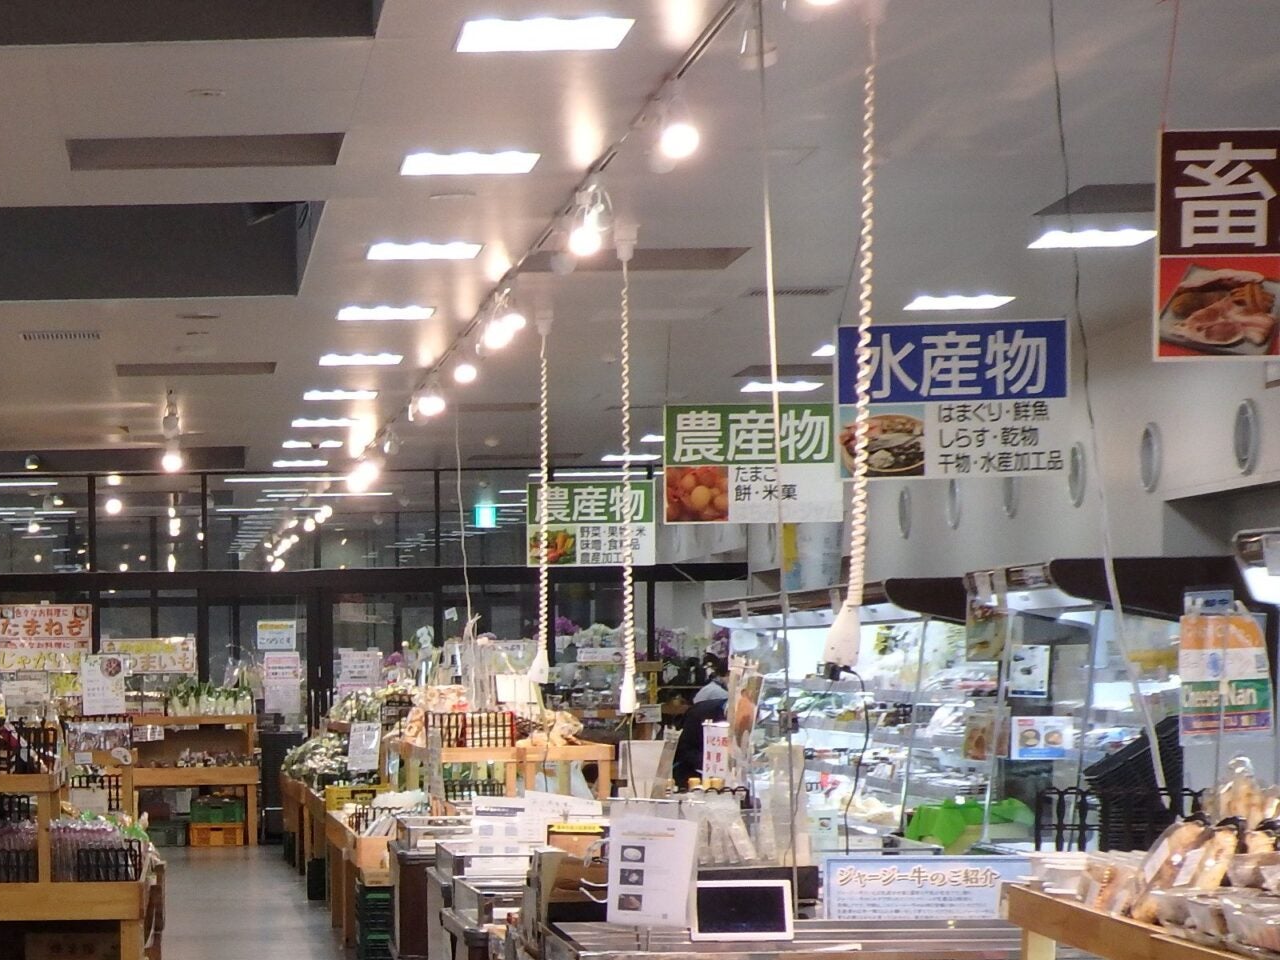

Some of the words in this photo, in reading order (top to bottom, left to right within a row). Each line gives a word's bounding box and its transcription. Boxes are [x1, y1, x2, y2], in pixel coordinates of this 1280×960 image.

[1175, 142, 1277, 247] 畜
[858, 330, 1048, 398] 水産物
[938, 402, 1050, 423] はまぐり・鮮魚
[673, 409, 830, 462] 農産物
[939, 427, 1039, 448] しらす・乾物
[938, 450, 1063, 474] 干物・水産加工品
[735, 466, 778, 482] たまご
[535, 486, 645, 522] 農産物
[735, 484, 798, 502] 餅・米菓
[1, 618, 86, 638] たまねぎ
[839, 864, 1000, 887] ジャージー牛のご紹介
